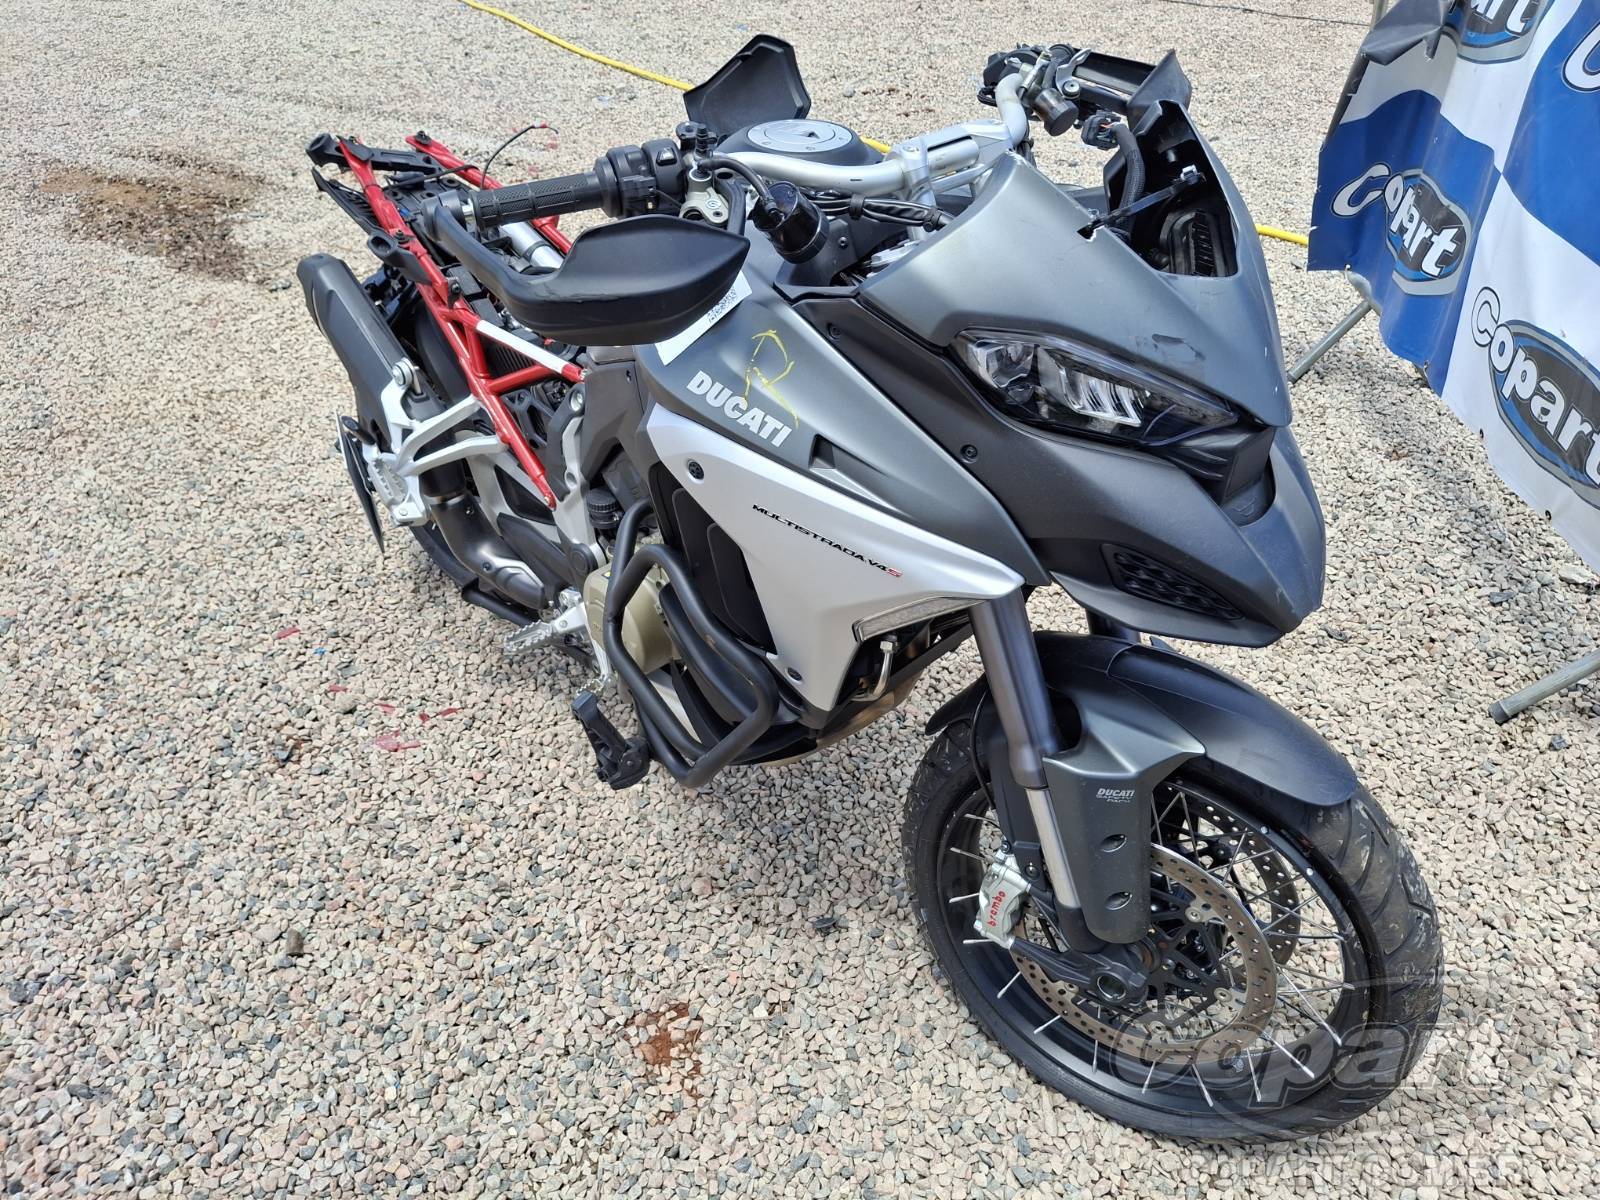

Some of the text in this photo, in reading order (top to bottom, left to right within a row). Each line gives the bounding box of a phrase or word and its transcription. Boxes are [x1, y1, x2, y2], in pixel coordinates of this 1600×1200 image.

[686, 370, 793, 448] DUCATI
[752, 504, 865, 562] MULTISTRADA
[1097, 787, 1135, 797] DUCATI
[986, 890, 1006, 927] brembo
